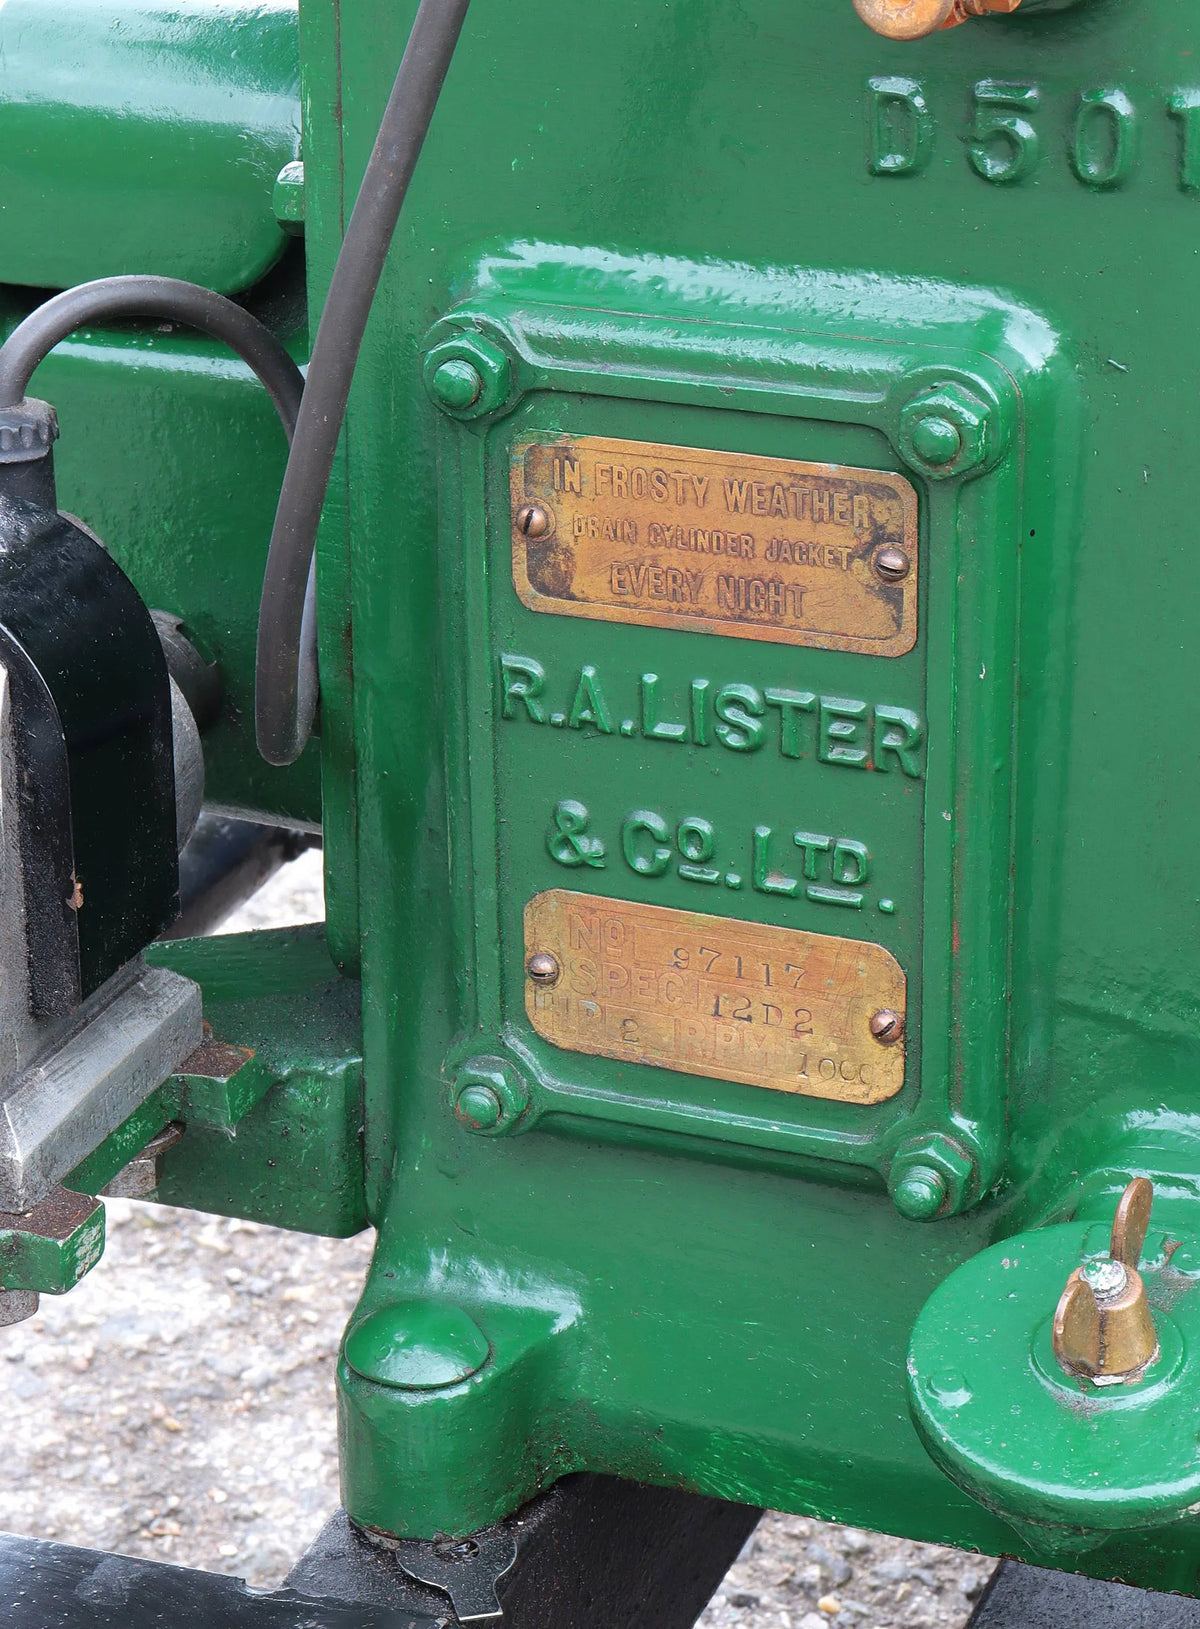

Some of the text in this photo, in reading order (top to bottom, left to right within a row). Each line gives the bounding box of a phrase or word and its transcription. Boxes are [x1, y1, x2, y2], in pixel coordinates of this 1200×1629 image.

[553, 458, 874, 529] IN FROSTY WEATHER
[573, 513, 853, 571] DRAIN CYLINDER JACKET
[611, 562, 808, 619] EVERY NIGHT
[570, 959, 690, 1011] SPEC
[673, 947, 809, 990] 97117
[621, 1017, 641, 1045] 2
